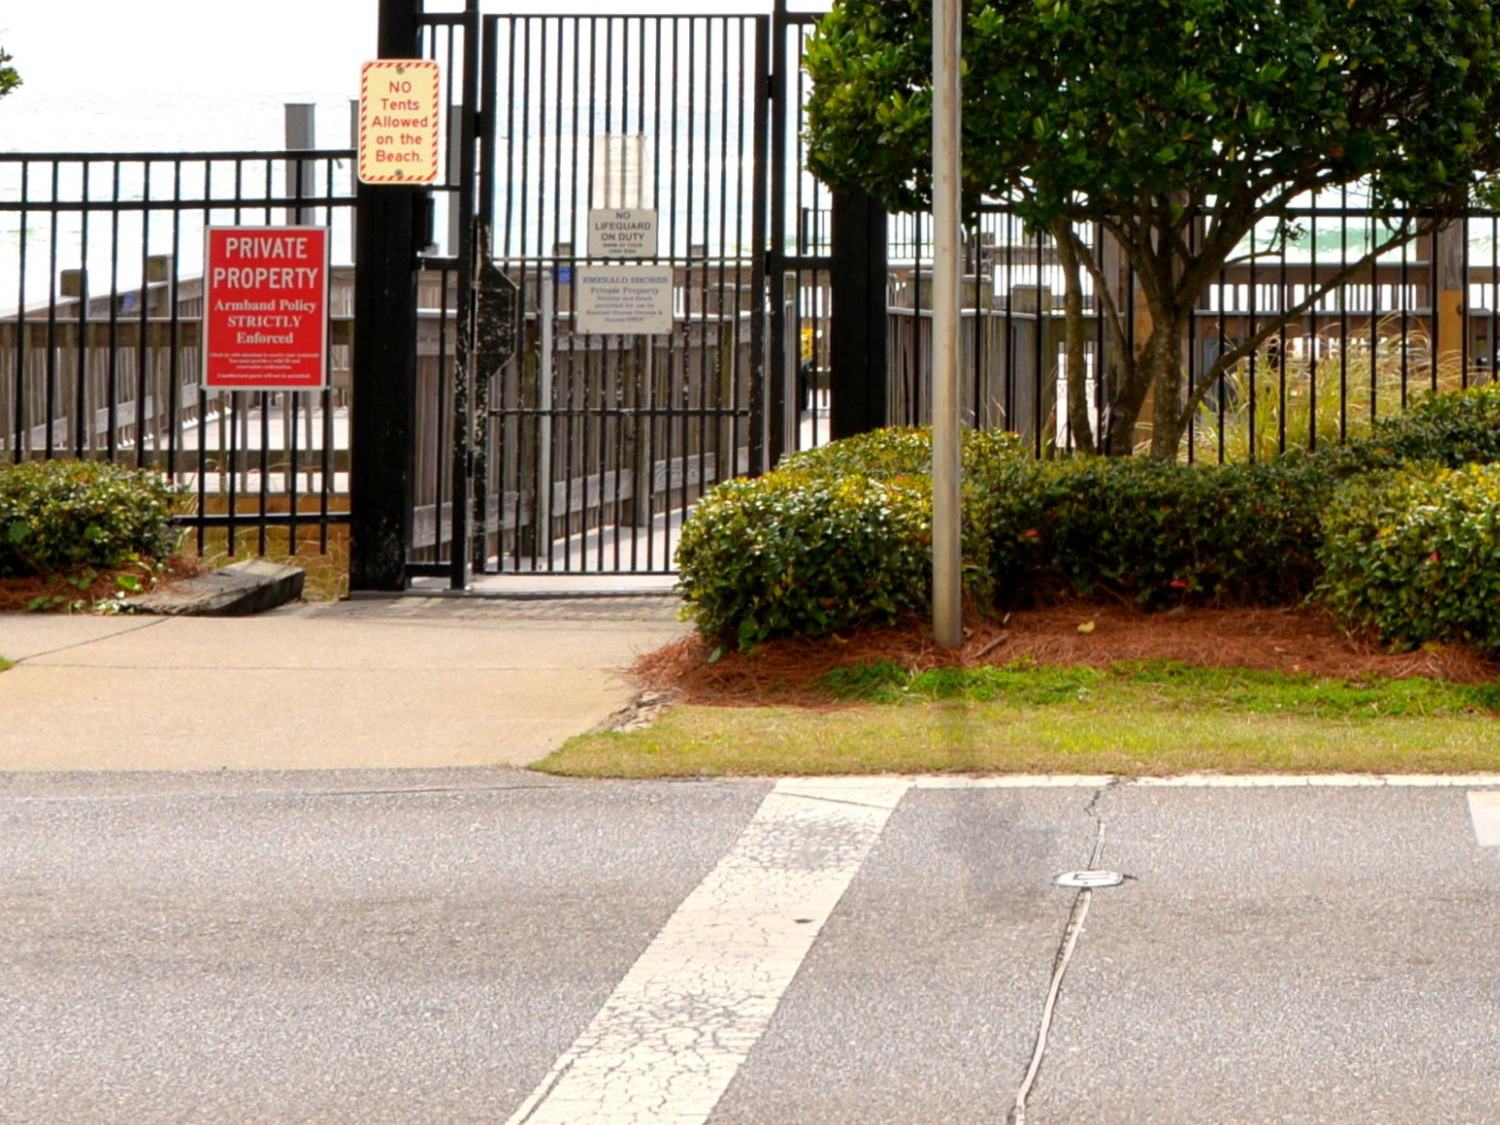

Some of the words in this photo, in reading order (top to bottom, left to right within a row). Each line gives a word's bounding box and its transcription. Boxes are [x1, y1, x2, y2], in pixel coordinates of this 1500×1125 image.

[388, 81, 412, 94] NO
[380, 98, 420, 111] Tents
[371, 115, 429, 128] Allowed
[375, 134, 394, 145] on
[399, 133, 423, 145] the
[375, 149, 424, 163] Beach.
[615, 211, 631, 220] NO
[594, 221, 652, 231] LIFEGUARD
[601, 233, 616, 242] ON
[618, 233, 645, 242] DUTY
[225, 236, 309, 259] PRIVATE
[213, 267, 319, 289] PROPERTY
[214, 299, 276, 312] Armband
[279, 299, 318, 314] Policy
[227, 315, 303, 328] STRICTLY
[236, 332, 294, 344] Enforced
